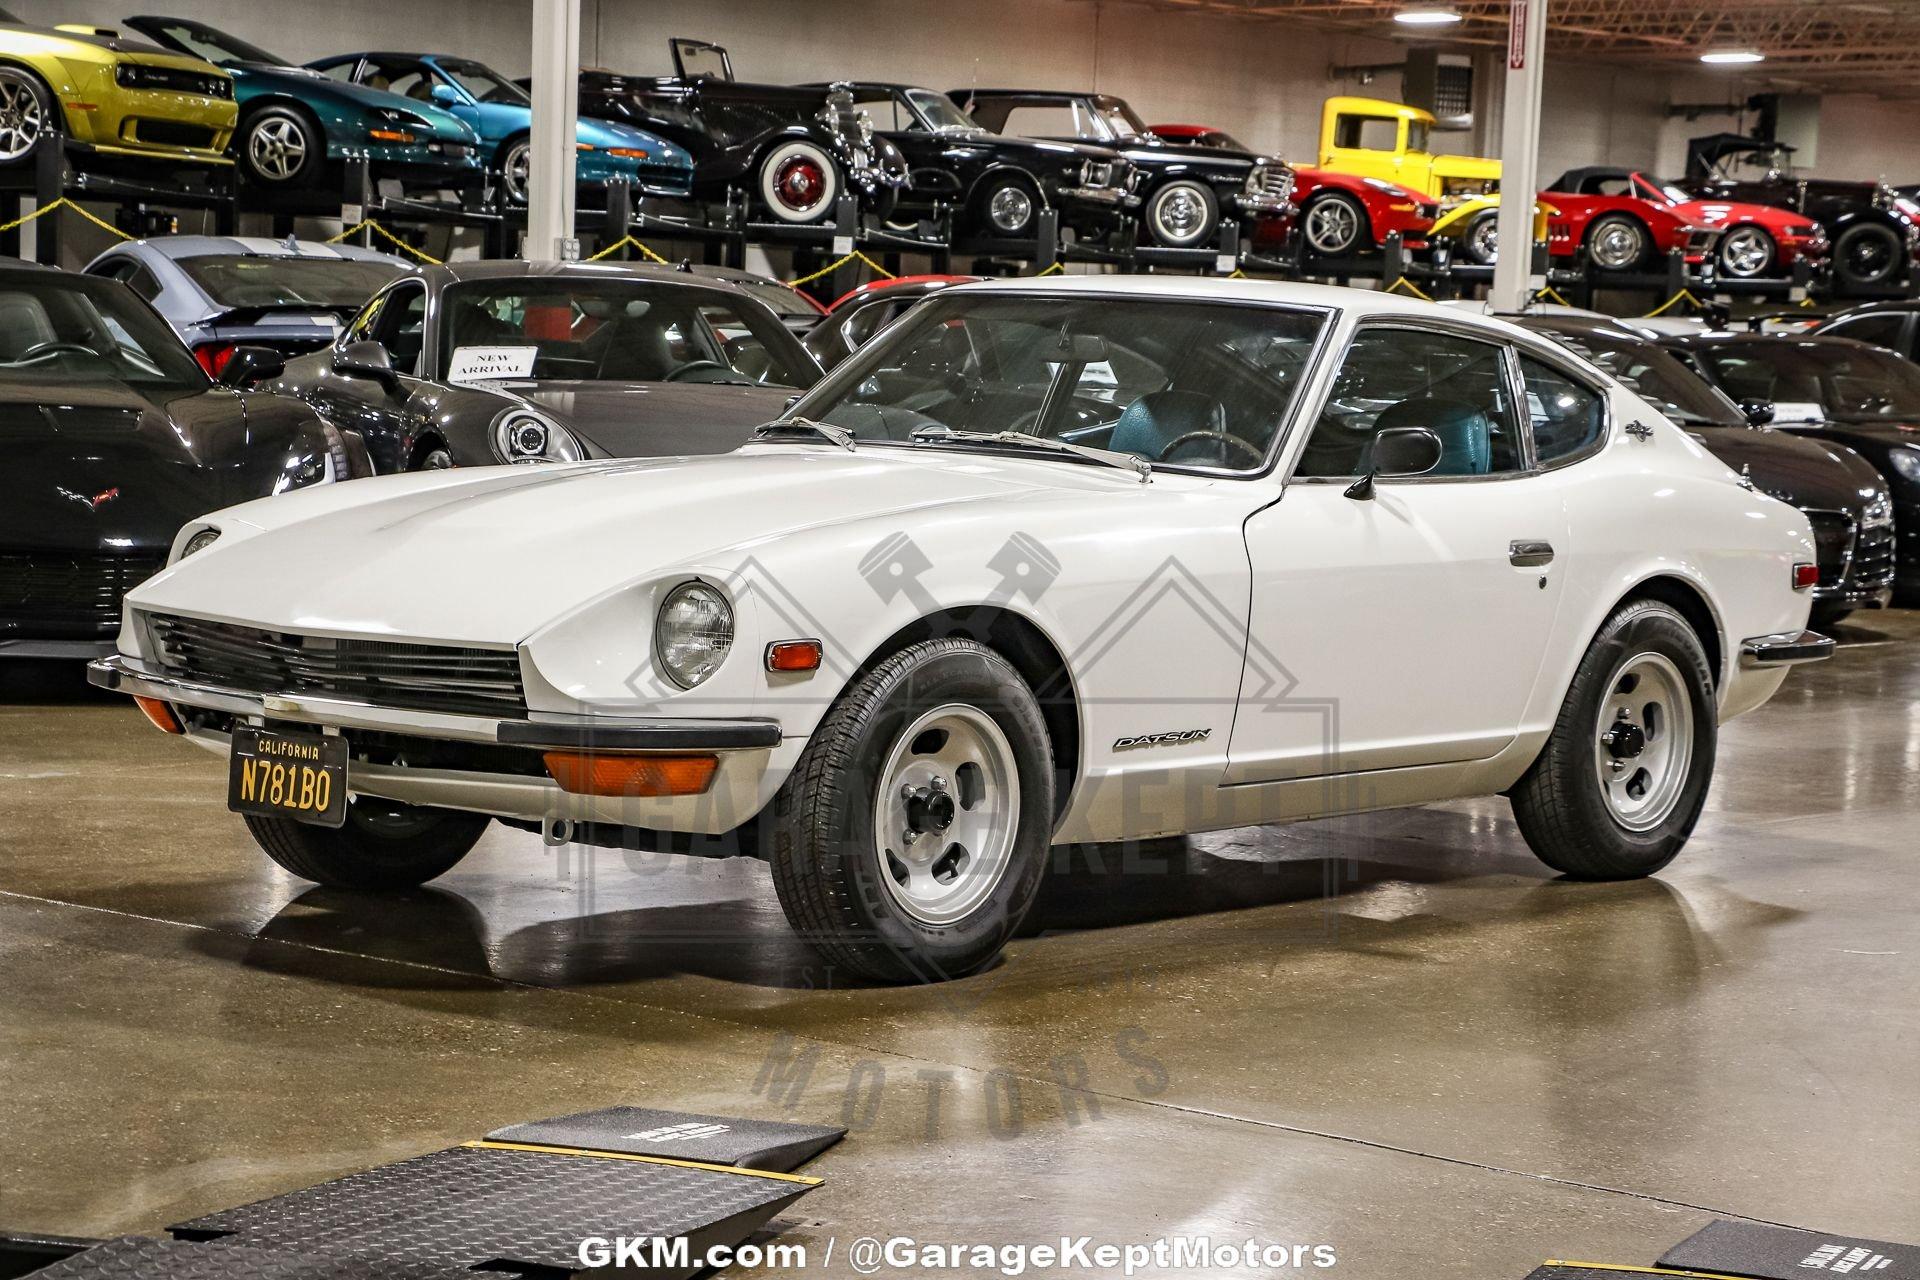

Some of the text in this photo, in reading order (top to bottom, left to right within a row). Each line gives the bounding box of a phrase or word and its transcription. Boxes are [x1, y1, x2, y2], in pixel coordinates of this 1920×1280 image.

[458, 365, 523, 375] ARRIVAL
[1113, 729, 1212, 749] DATSUN
[258, 740, 319, 760] CALIFORNIA
